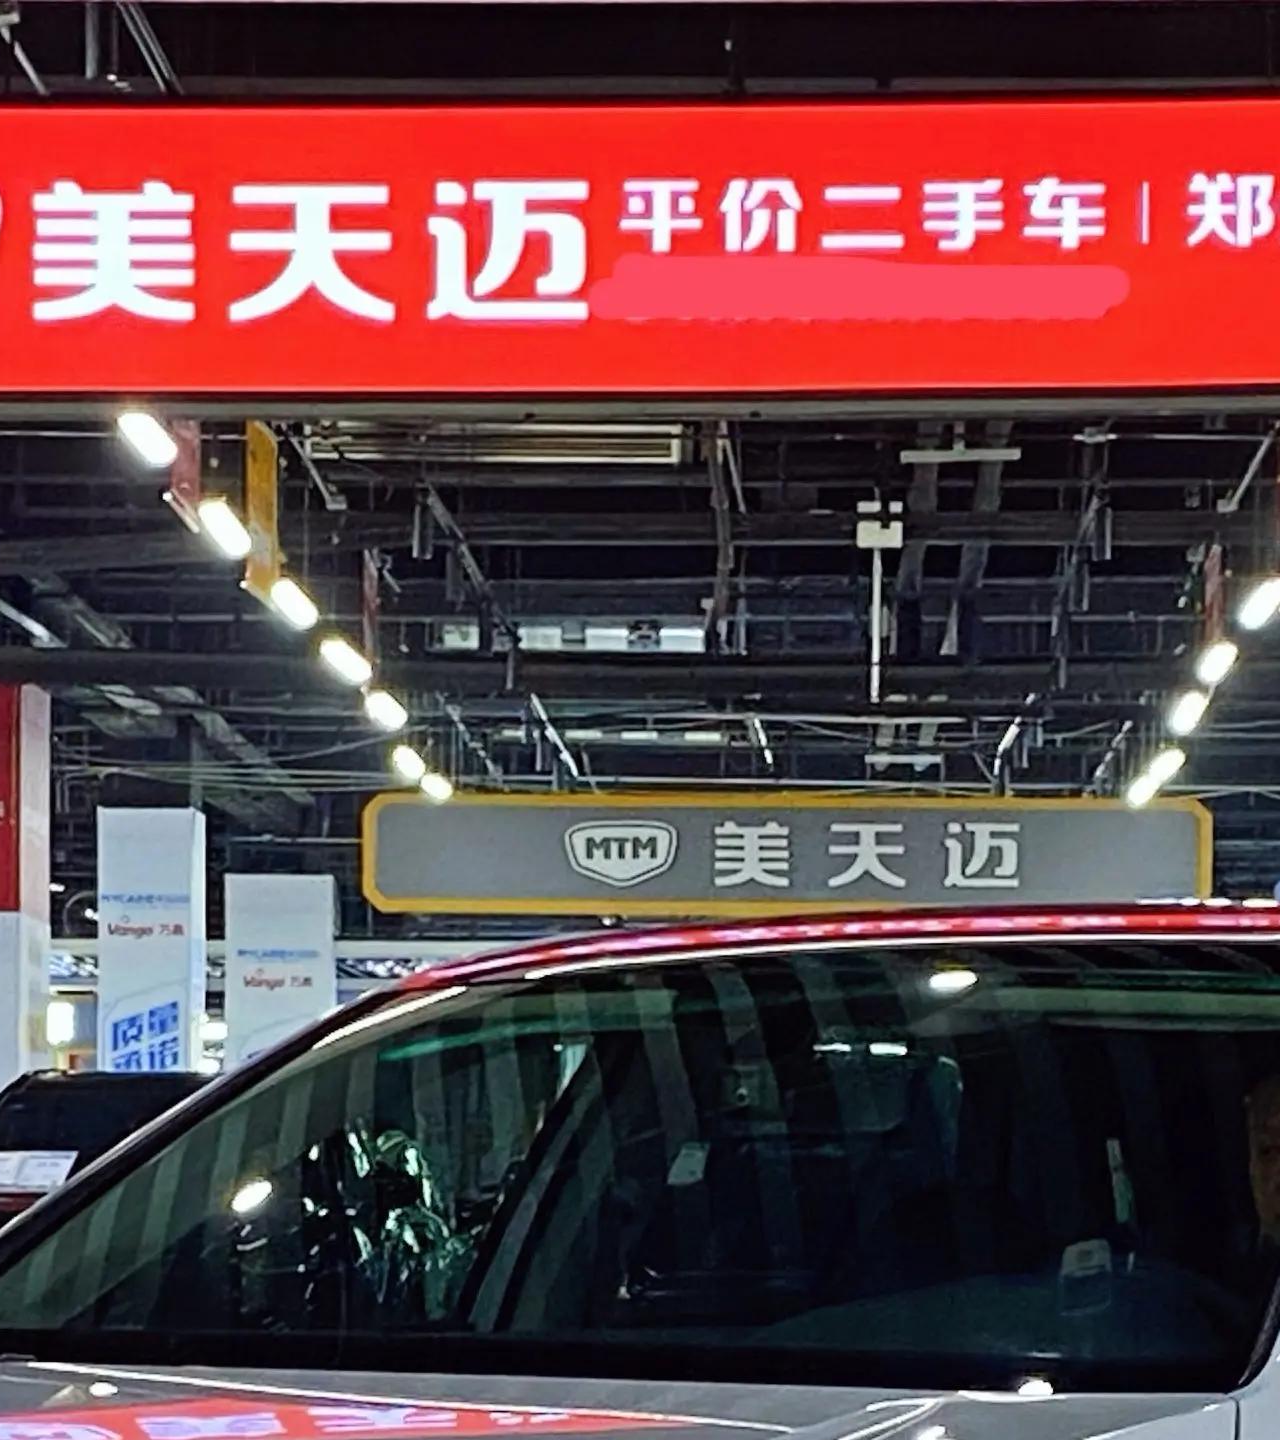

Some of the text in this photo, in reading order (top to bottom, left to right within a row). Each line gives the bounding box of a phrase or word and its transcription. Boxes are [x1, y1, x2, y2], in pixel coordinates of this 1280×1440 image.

[618, 177, 1108, 253] 平价二手车
[31, 180, 590, 323] 美天迈
[584, 820, 1020, 889] MTM 美天迈
[112, 1001, 179, 1051] 质量
